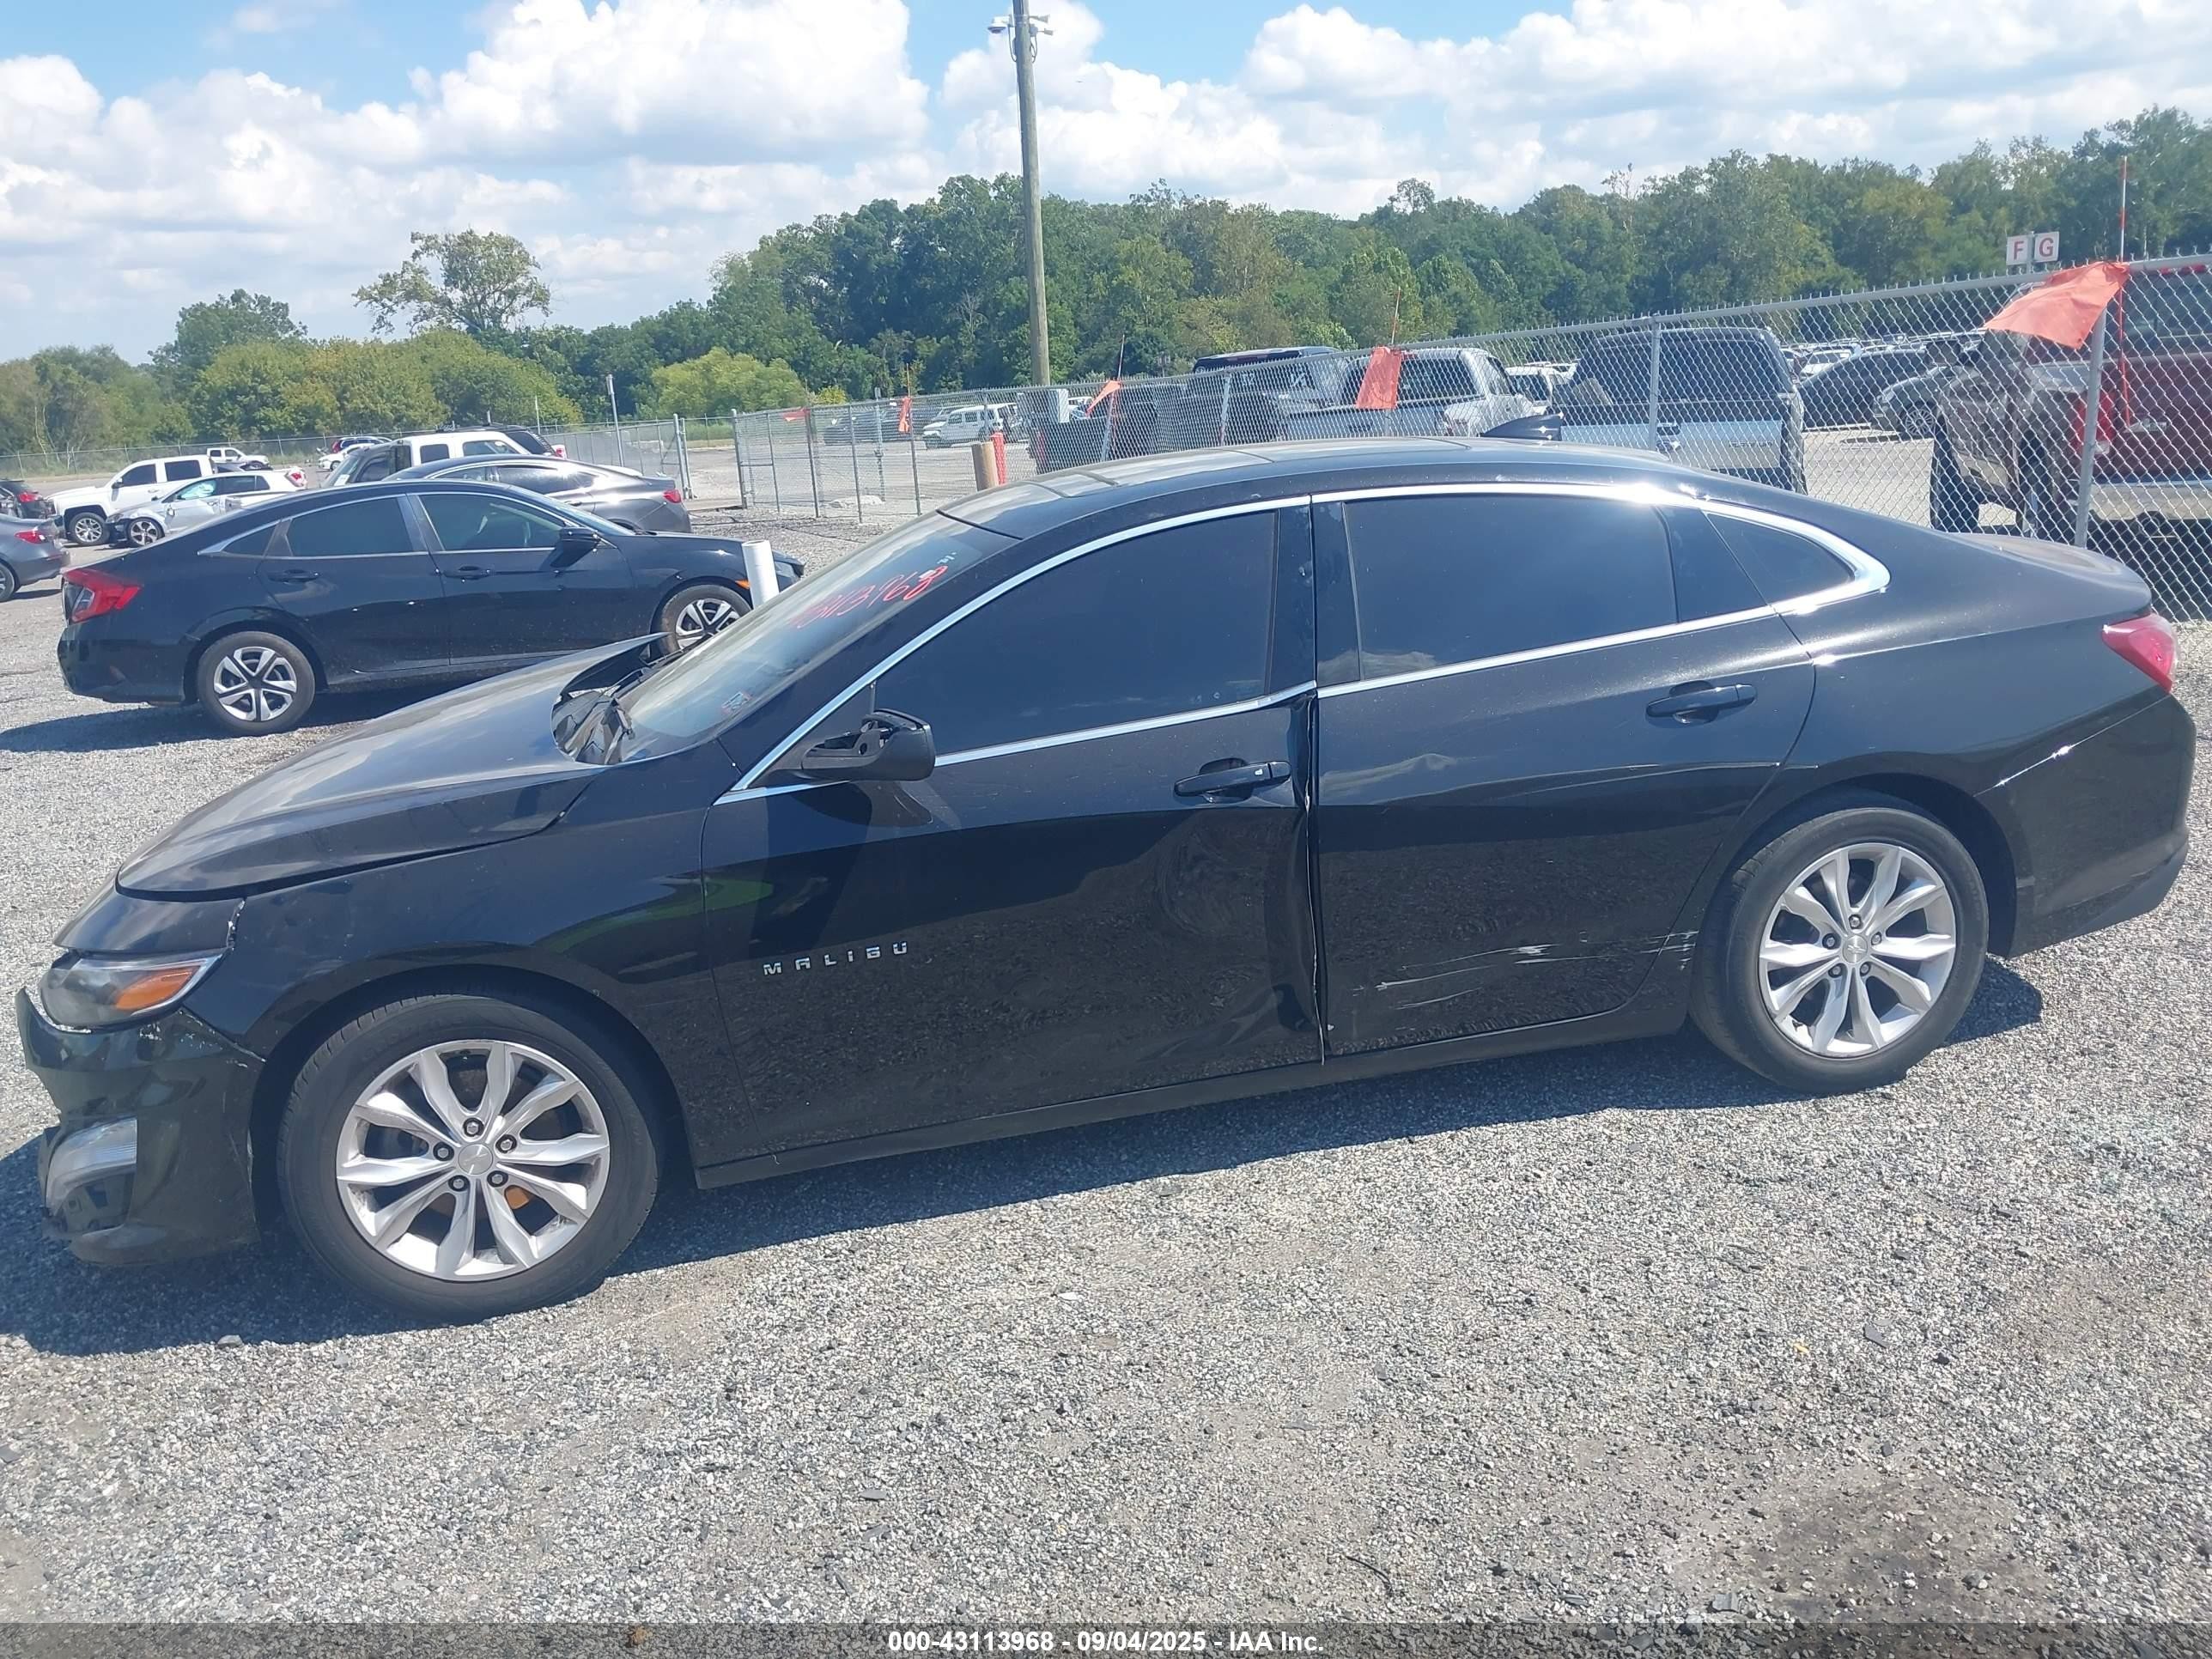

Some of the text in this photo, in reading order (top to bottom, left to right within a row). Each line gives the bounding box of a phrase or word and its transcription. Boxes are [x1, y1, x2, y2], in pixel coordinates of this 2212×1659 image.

[2013, 240, 2025, 260] F
[2039, 237, 2054, 258] G
[763, 941, 908, 975] MALIBU
